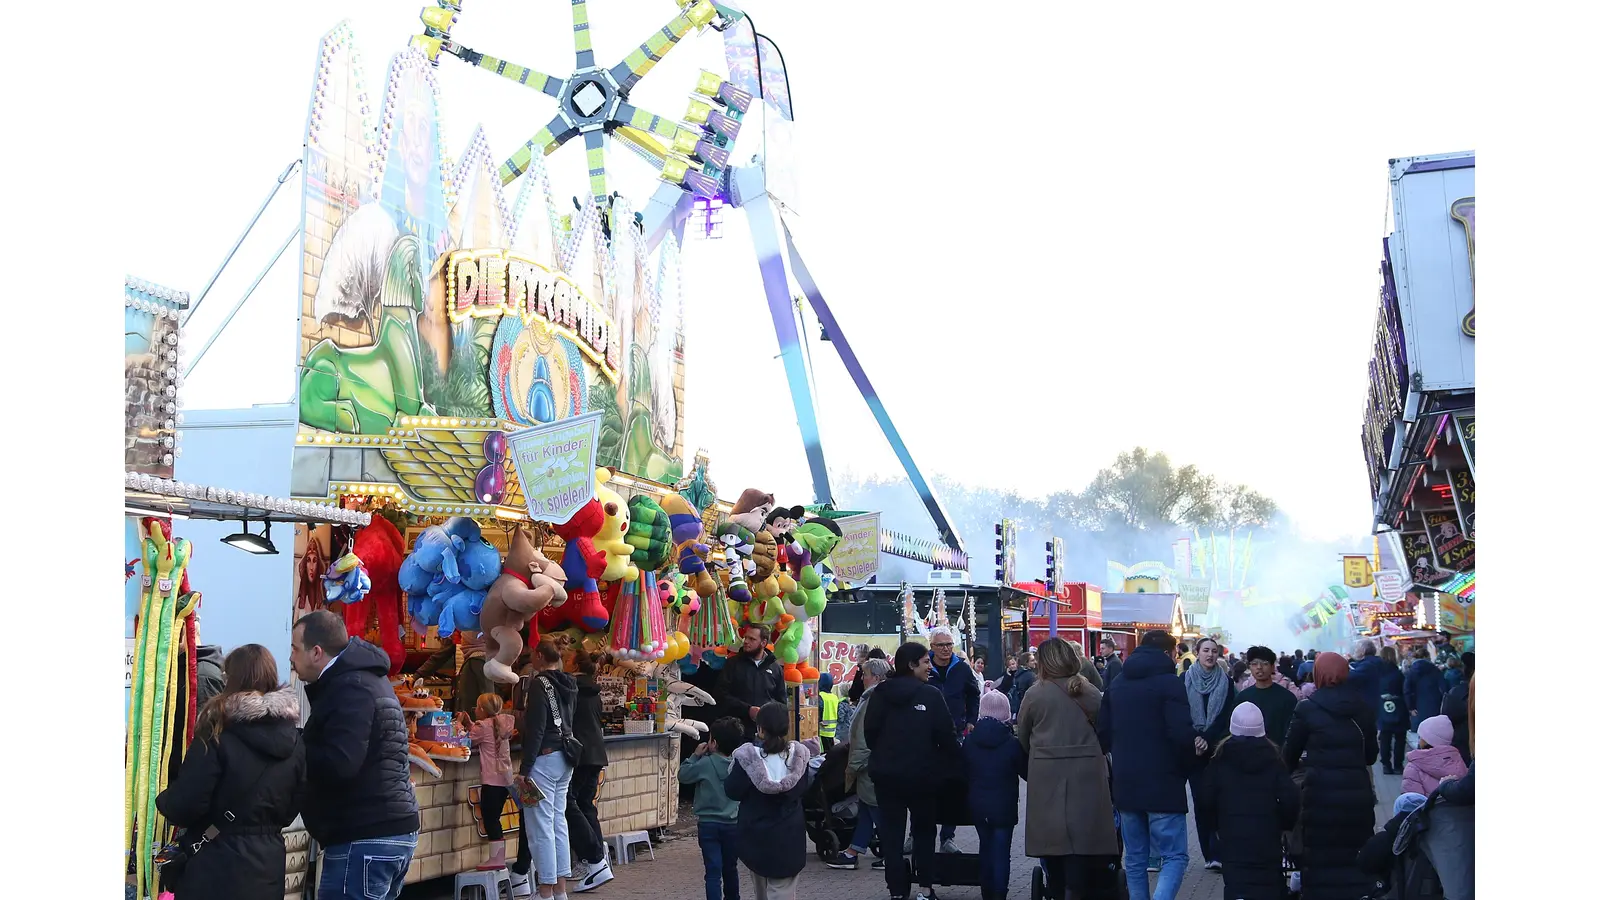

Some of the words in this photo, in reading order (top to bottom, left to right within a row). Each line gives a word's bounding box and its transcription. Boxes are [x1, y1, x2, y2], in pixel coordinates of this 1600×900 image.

[457, 257, 505, 311] DIE
[508, 261, 621, 372] PYRAMIDE
[522, 450, 539, 465] für
[542, 438, 588, 459] Kinder:
[531, 498, 546, 515] 2x
[547, 480, 591, 512] spielen!
[843, 530, 875, 541] Kinder:
[1413, 568, 1424, 582] 5
